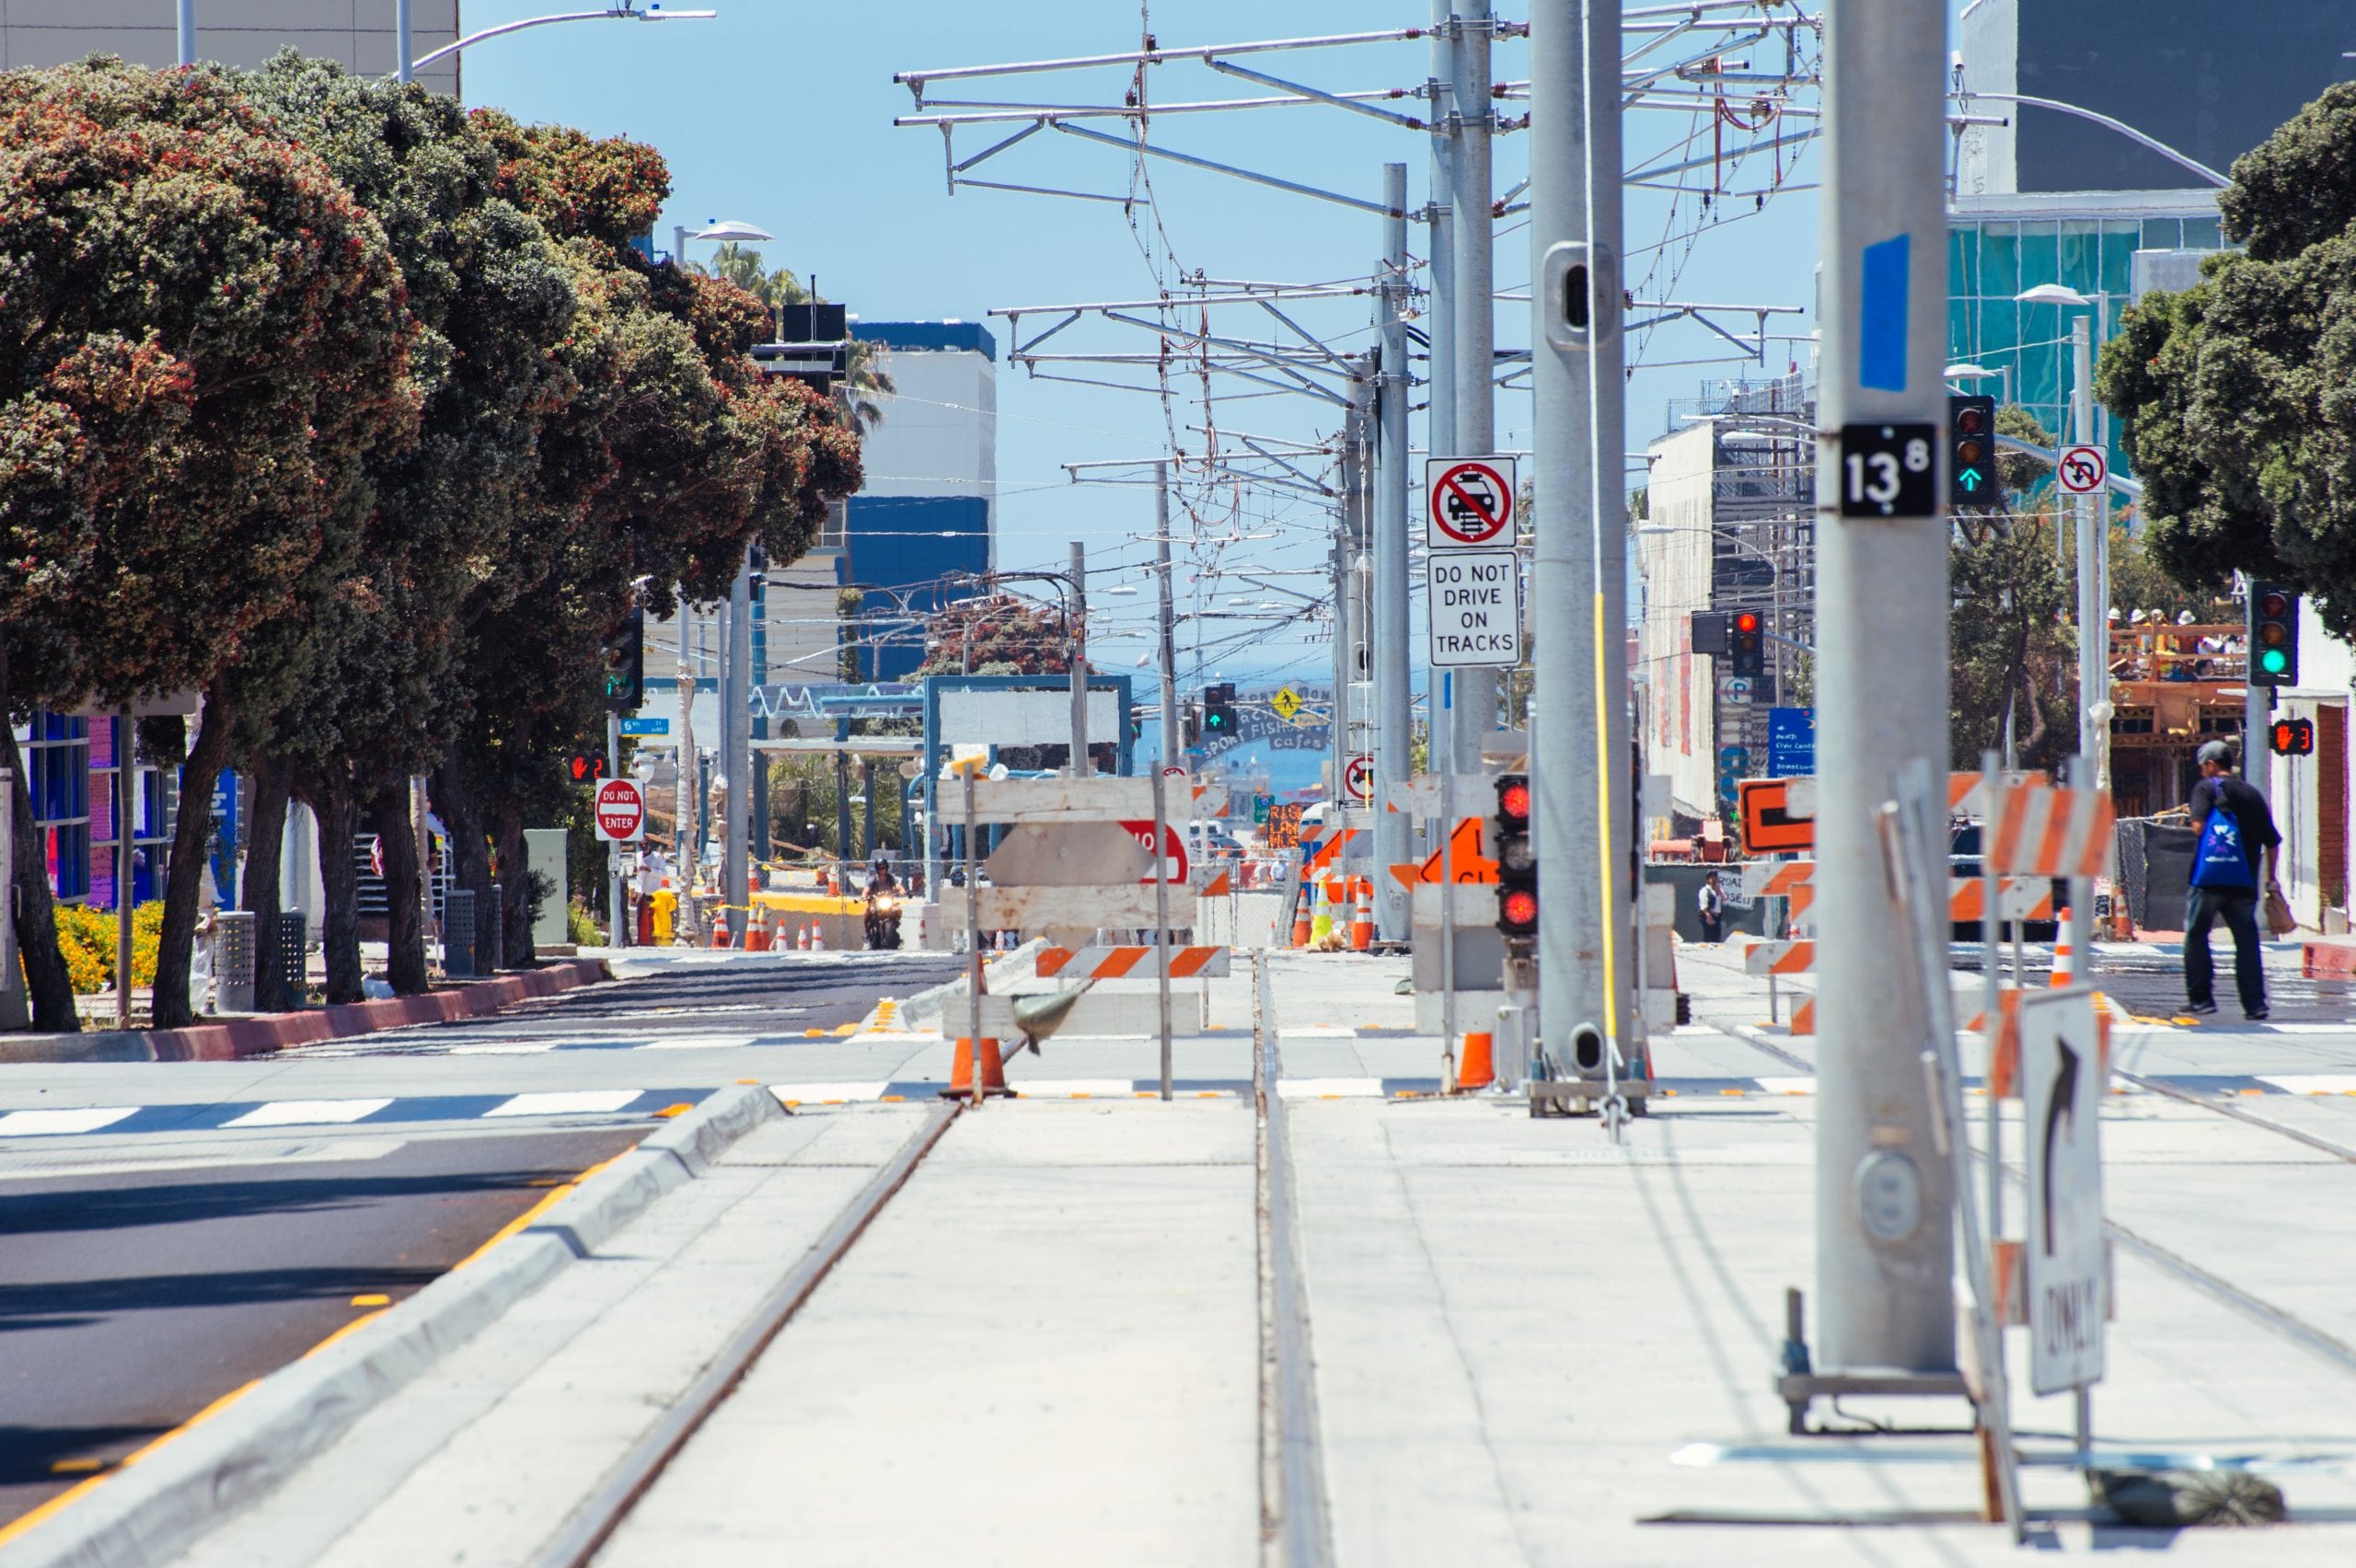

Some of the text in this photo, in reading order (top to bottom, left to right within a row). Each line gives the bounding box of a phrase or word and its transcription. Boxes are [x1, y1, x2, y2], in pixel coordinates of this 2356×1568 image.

[1435, 564, 1509, 583] DO NOT
[1444, 588, 1502, 606] DRIVE
[1461, 612, 1487, 628] ON
[1437, 634, 1513, 652] TRACKS
[2301, 728, 2309, 749] 3
[594, 759, 603, 778] 2
[603, 791, 634, 801] DO NOT
[606, 817, 633, 828] ENTER
